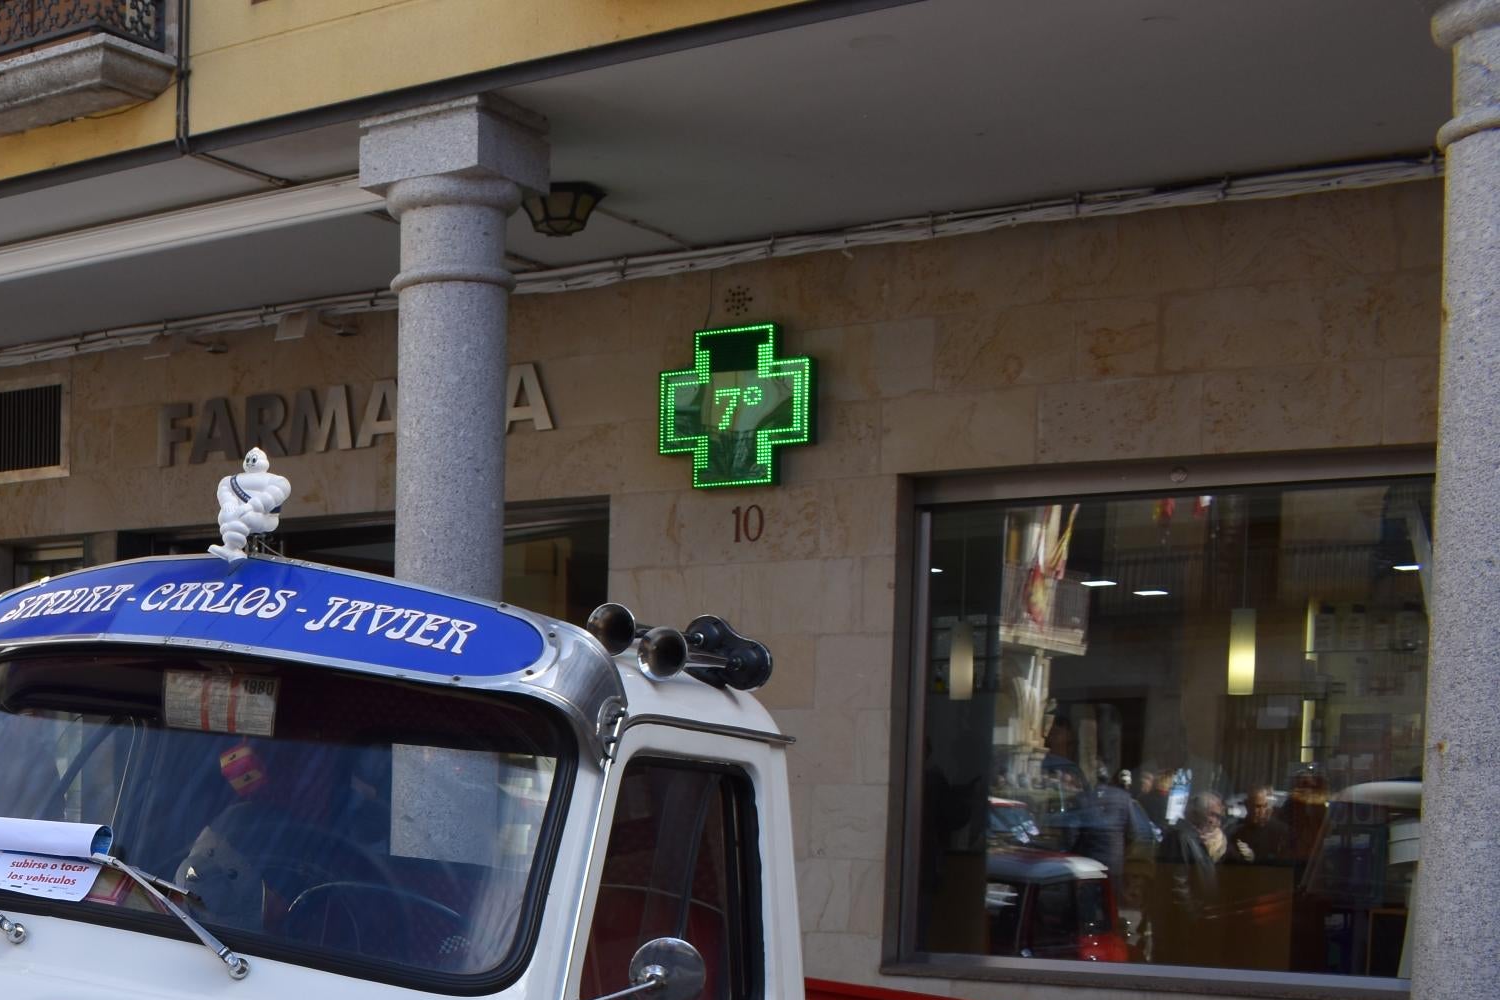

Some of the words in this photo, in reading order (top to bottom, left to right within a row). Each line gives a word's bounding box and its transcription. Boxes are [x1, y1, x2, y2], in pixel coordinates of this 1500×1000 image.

[157, 360, 554, 467] FARMAA
[732, 504, 764, 543] 10
[140, 581, 296, 619] CARLOS
[306, 596, 478, 655] JAVIER
[7, 871, 23, 881] los
[10, 859, 48, 870] subirse
[60, 862, 90, 873] tocar
